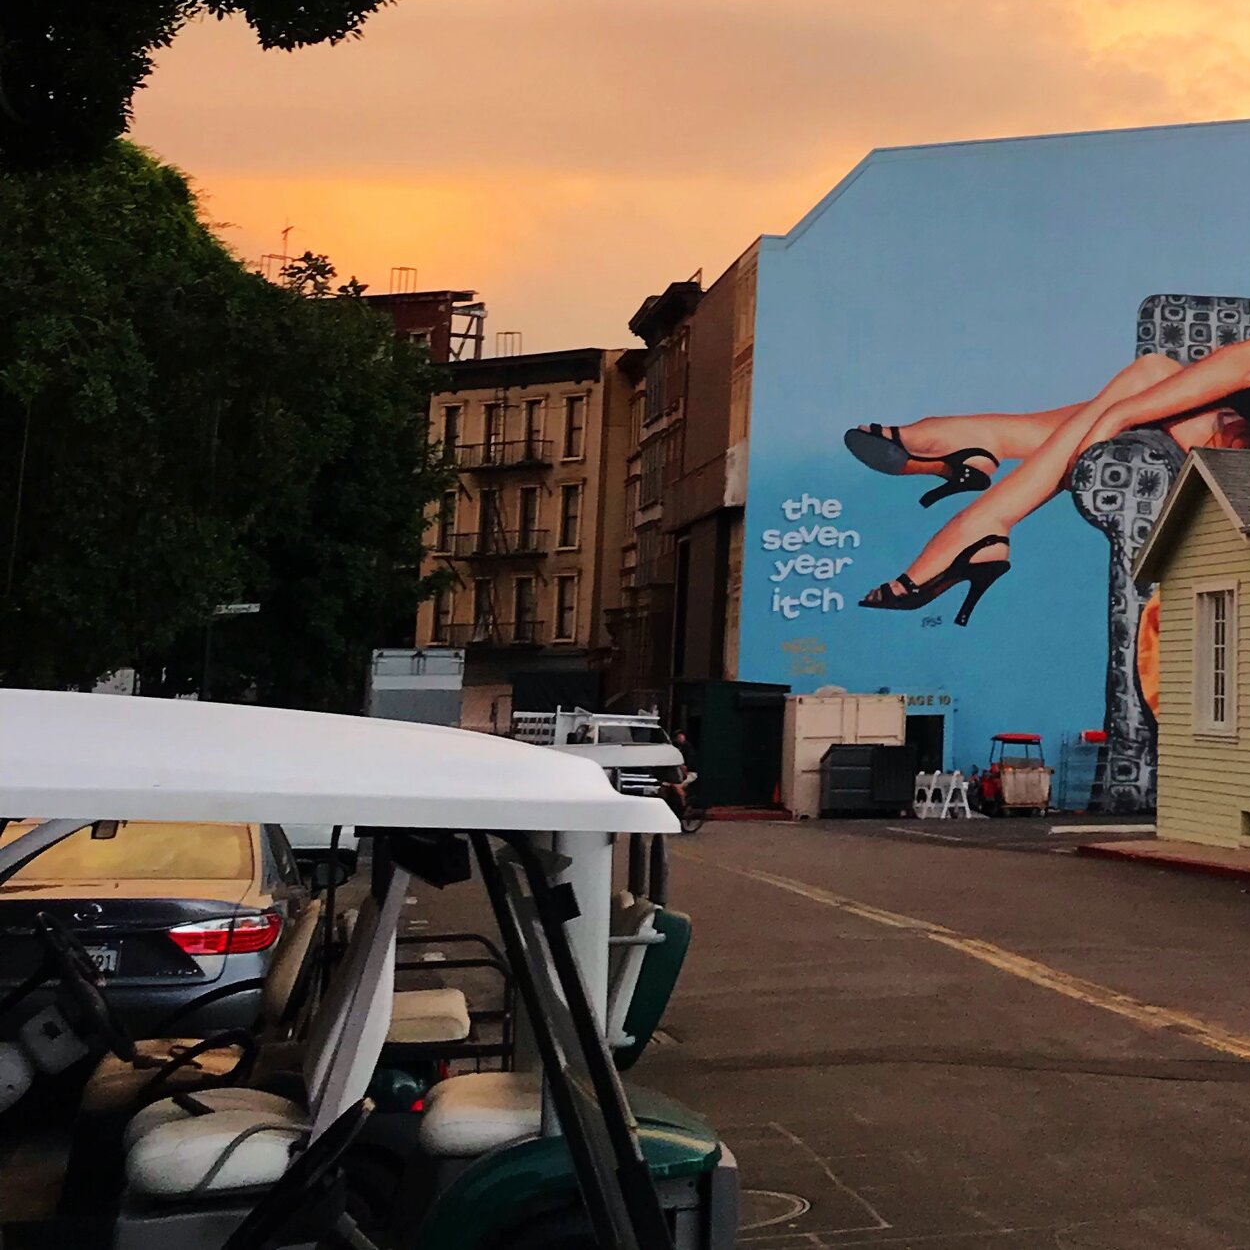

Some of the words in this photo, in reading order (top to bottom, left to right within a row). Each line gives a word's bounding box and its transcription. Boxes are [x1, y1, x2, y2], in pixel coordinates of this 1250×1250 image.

[782, 493, 842, 521] the
[762, 524, 861, 552] seven
[769, 554, 854, 582] year
[772, 587, 844, 619] itch
[906, 695, 934, 707] AGE
